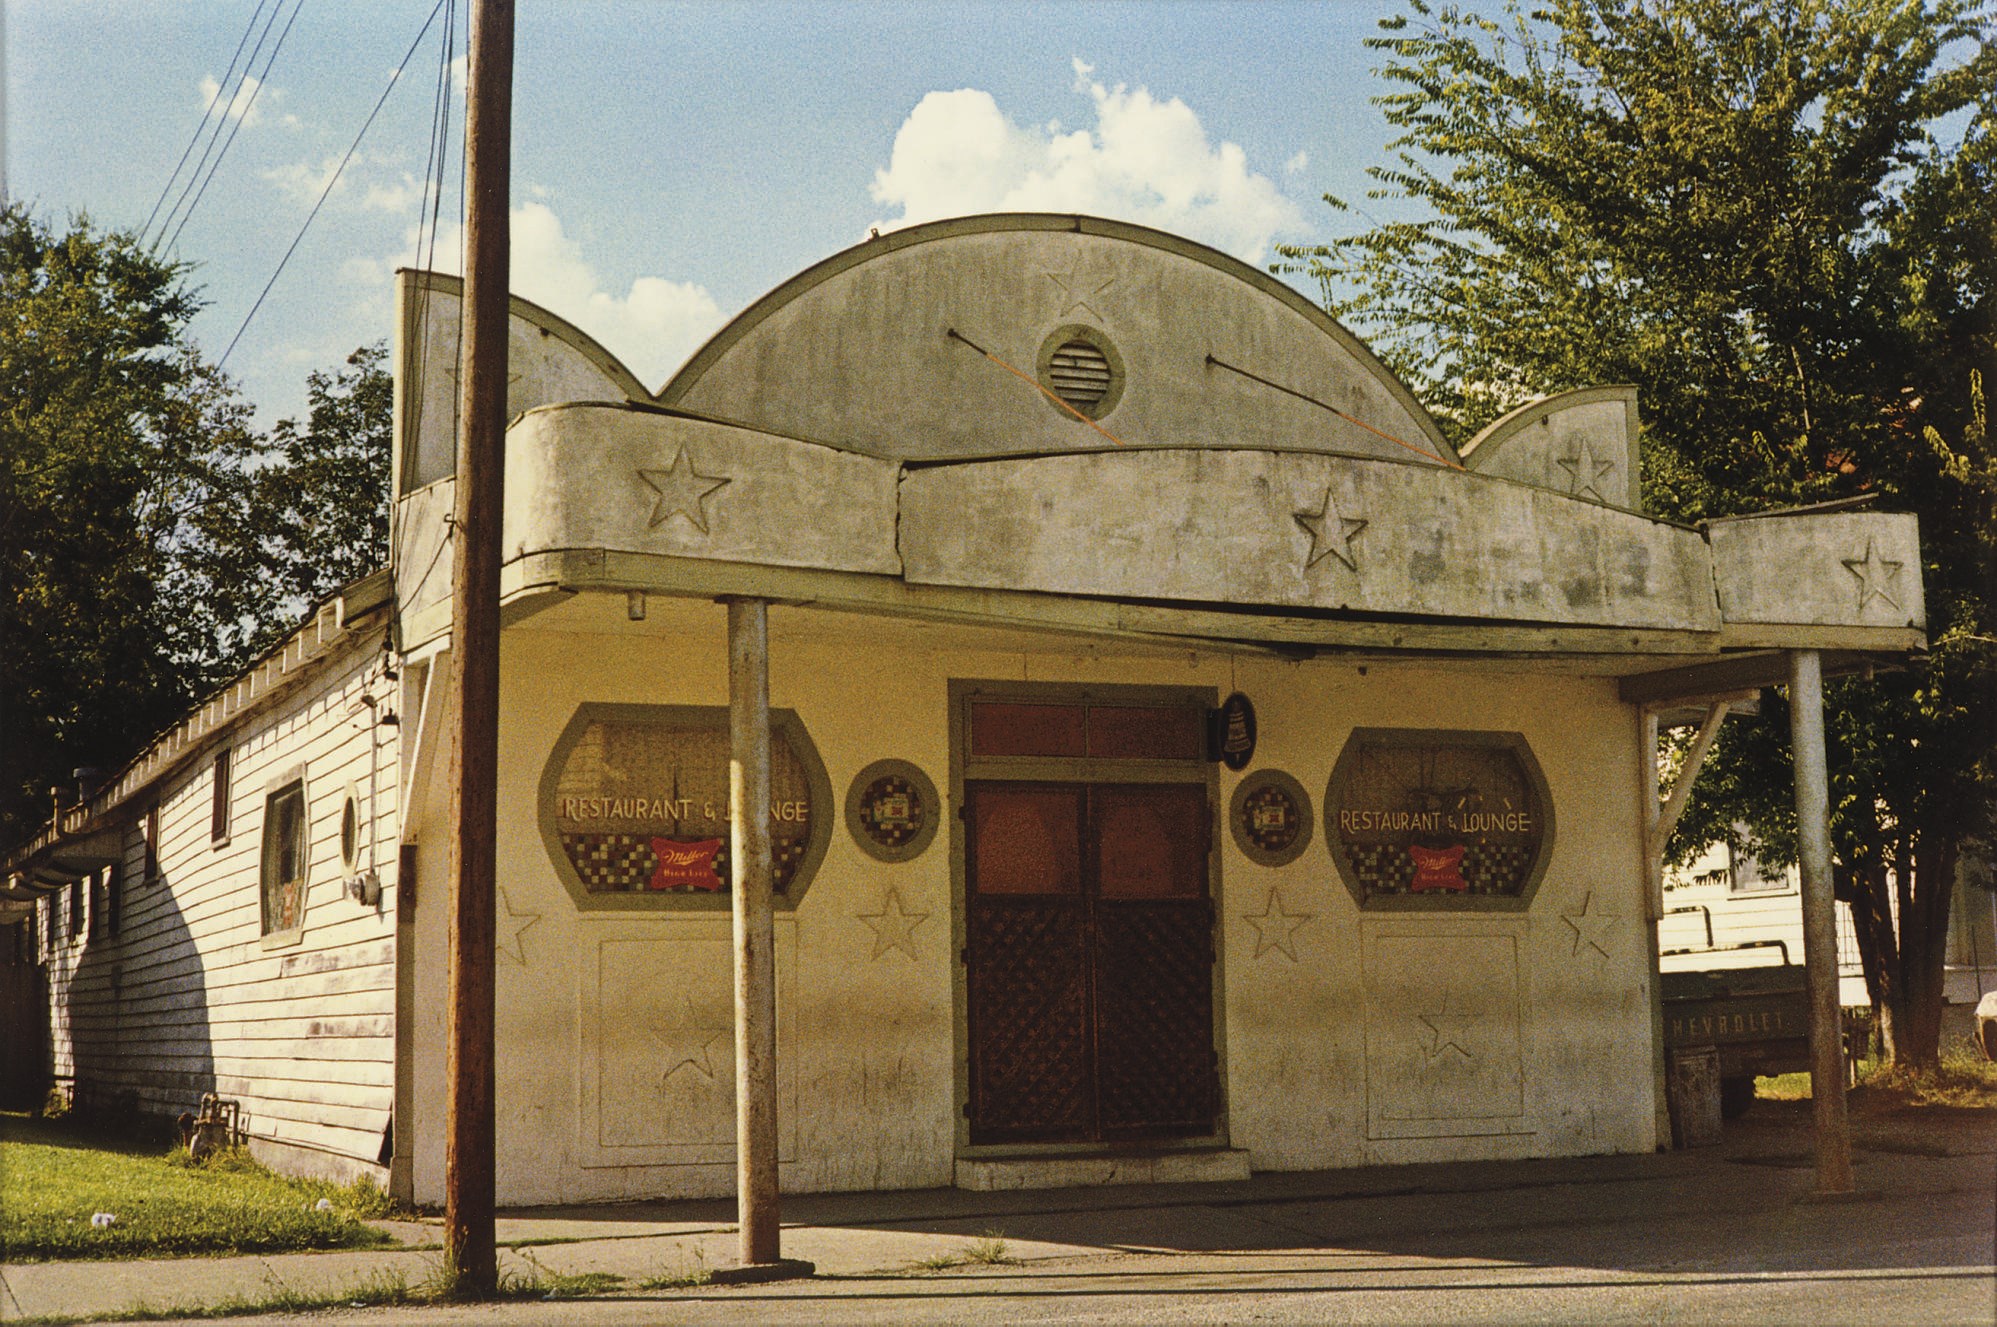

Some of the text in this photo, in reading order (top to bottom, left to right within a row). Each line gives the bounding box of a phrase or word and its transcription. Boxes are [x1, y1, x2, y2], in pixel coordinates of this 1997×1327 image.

[563, 798, 809, 822] RESTAURANT & LNGE
[1340, 810, 1532, 834] RESTAURANT & LOUNGE
[663, 849, 709, 865] Miller
[1672, 1011, 1783, 1037] HEVROLET
